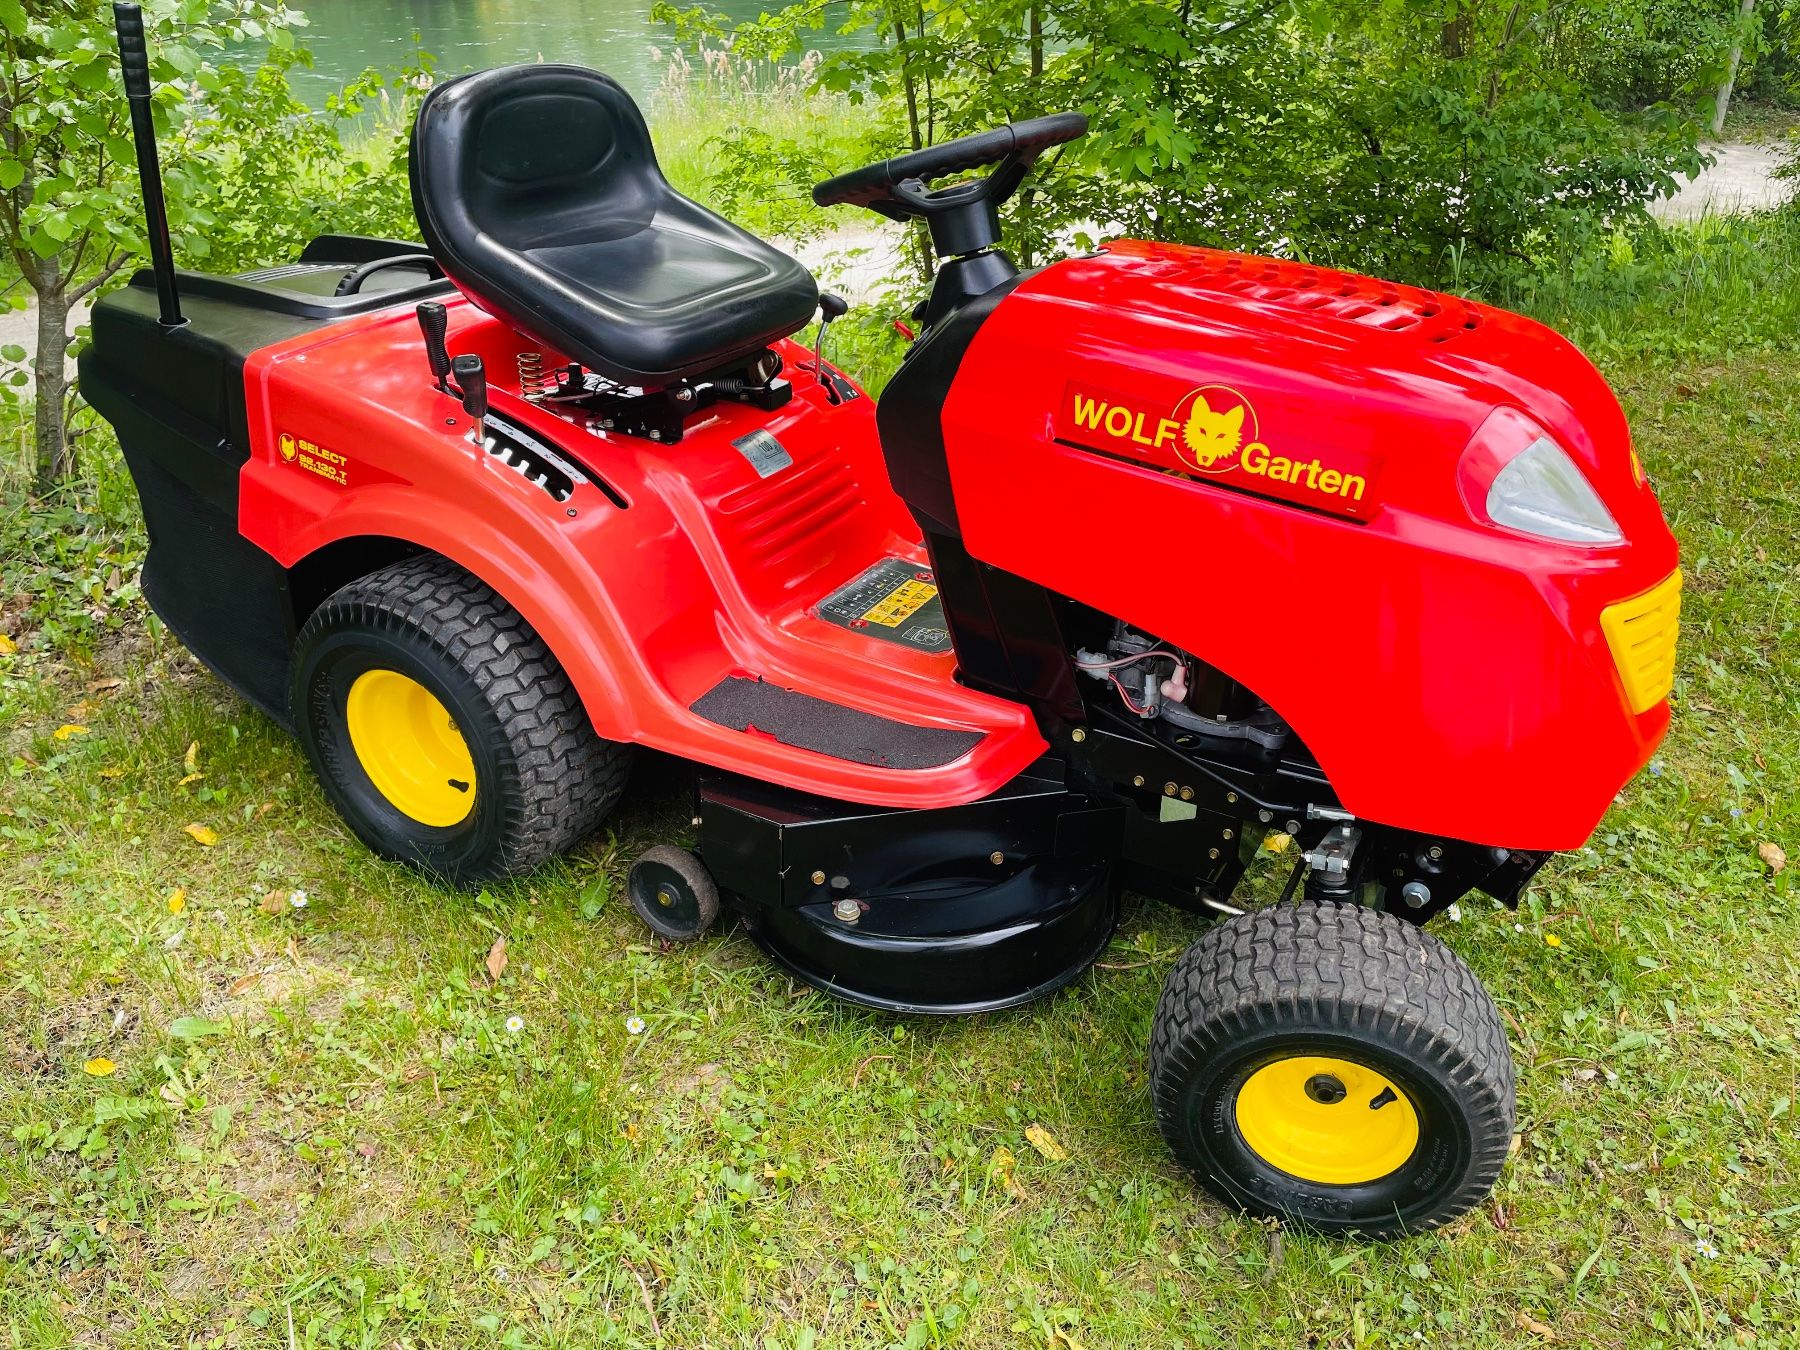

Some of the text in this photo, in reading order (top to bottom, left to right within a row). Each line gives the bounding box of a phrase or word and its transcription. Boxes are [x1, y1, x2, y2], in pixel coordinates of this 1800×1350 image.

[298, 440, 347, 466] SELECT
[1073, 394, 1366, 501] WOLF Garten
[299, 461, 347, 485] TRANSMATIC
[339, 470, 347, 479] T
